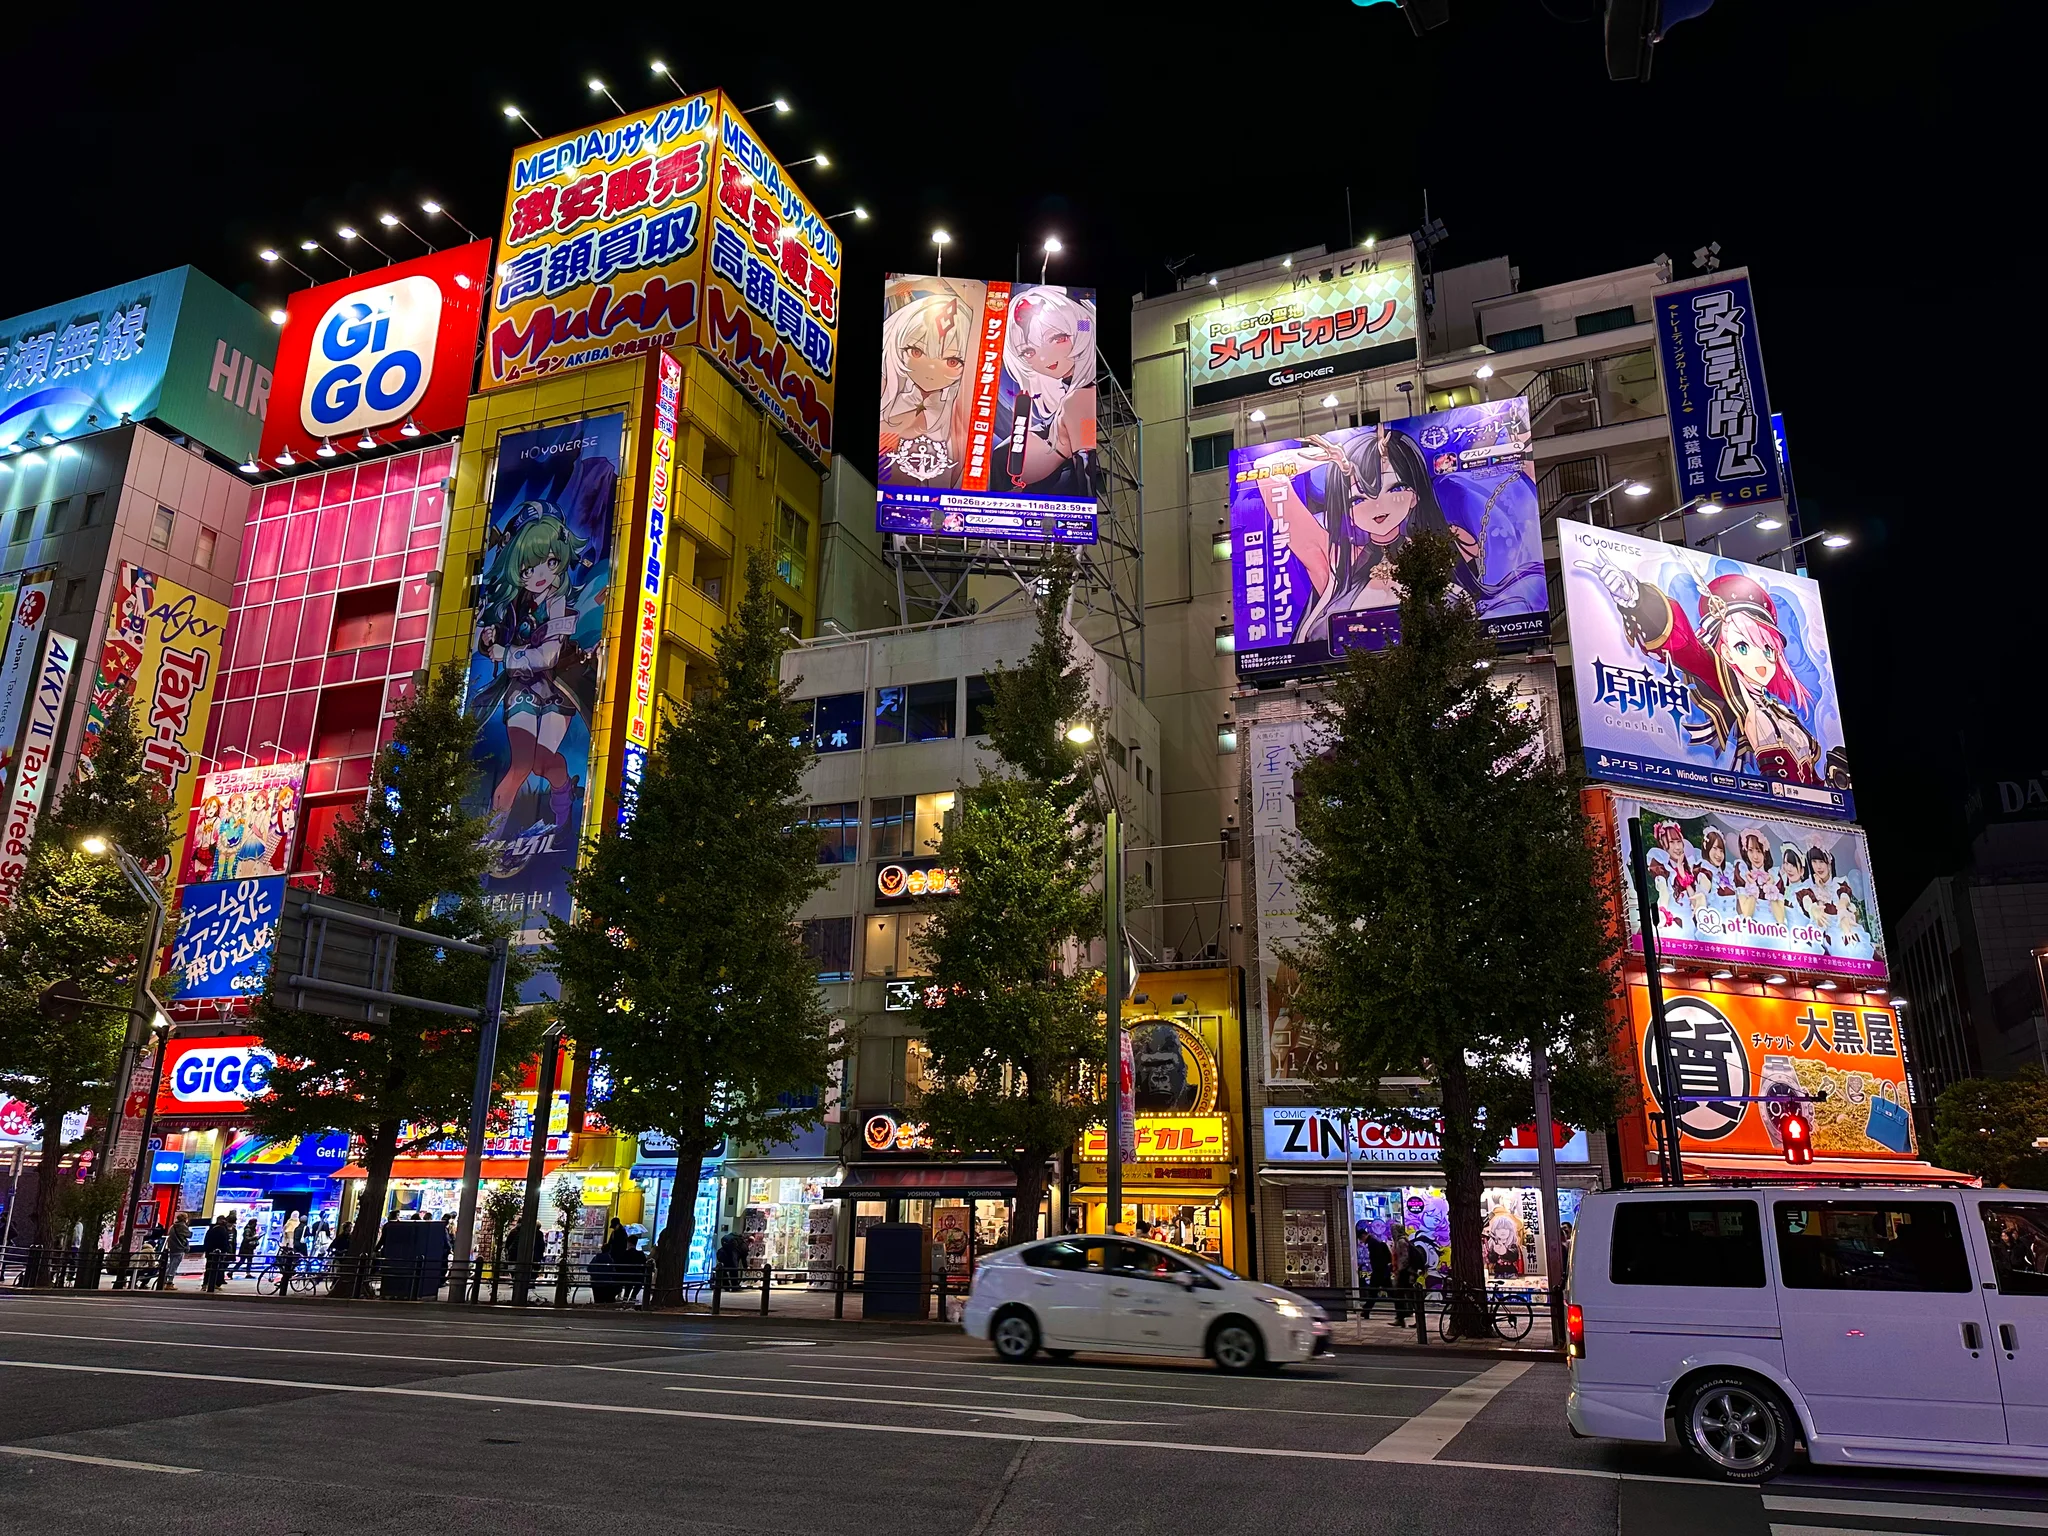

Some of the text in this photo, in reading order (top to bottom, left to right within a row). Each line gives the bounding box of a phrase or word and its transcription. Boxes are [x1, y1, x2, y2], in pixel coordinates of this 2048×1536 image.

[508, 142, 704, 243] 激安販売
[498, 204, 696, 307] 高額買取
[720, 157, 836, 323] 激安販売
[713, 225, 834, 377] 高額買取
[988, 291, 1008, 299] SSR
[490, 279, 696, 380] Mulan
[1208, 299, 1397, 370] メイドカジノ
[1210, 305, 1304, 339] Pokerの聖地
[0, 303, 150, 393] 瀬無線
[506, 356, 565, 382] ムーラン
[565, 346, 609, 367] AKIBA
[708, 286, 832, 450] Mulan
[1670, 311, 1693, 407] トレーディングカードゲーム
[718, 347, 759, 394] ムーラン
[758, 389, 786, 423] AKIBA
[1695, 292, 1765, 480] アメニティドリーム
[520, 435, 598, 460] HOYOVERSE
[975, 422, 988, 430] CV
[1452, 420, 1522, 444] アズールレーン
[651, 435, 671, 512] ムーラン
[1463, 448, 1491, 459] アズレン
[1682, 425, 1705, 486] 秋葉原店
[1236, 467, 1271, 484] SSR
[968, 516, 994, 524] アズレン
[1246, 534, 1262, 543] CV
[645, 509, 664, 596] AKIBA
[1271, 486, 1293, 639] ゴールデン・ハインド
[1575, 533, 1643, 557] HOYOVERSE
[148, 602, 219, 639] AKKY
[1500, 620, 1543, 632] YOSTAR
[12, 634, 28, 676] Japan.
[38, 637, 70, 723] AKKY
[1591, 656, 1691, 740] 原神
[144, 653, 206, 800] Tax-fr
[1604, 714, 1665, 735] Genshin
[1611, 758, 1708, 784] PS5 PS4 Windows
[6, 744, 50, 856] Tax-free
[179, 879, 259, 937] ゲームの
[170, 890, 272, 971] オアシスに
[1727, 918, 1822, 943] at-home cafe
[1751, 1008, 1898, 1058] チケット 大黒屋
[176, 1055, 273, 1094] GiGO
[61, 1126, 79, 1138] hop
[1273, 1110, 1307, 1119] COMIC
[316, 1147, 336, 1158] Get
[1274, 1115, 1347, 1160] ZIN
[1695, 1379, 1724, 1396] PARADA
[1726, 1462, 1775, 1479] YOKOHAMA
